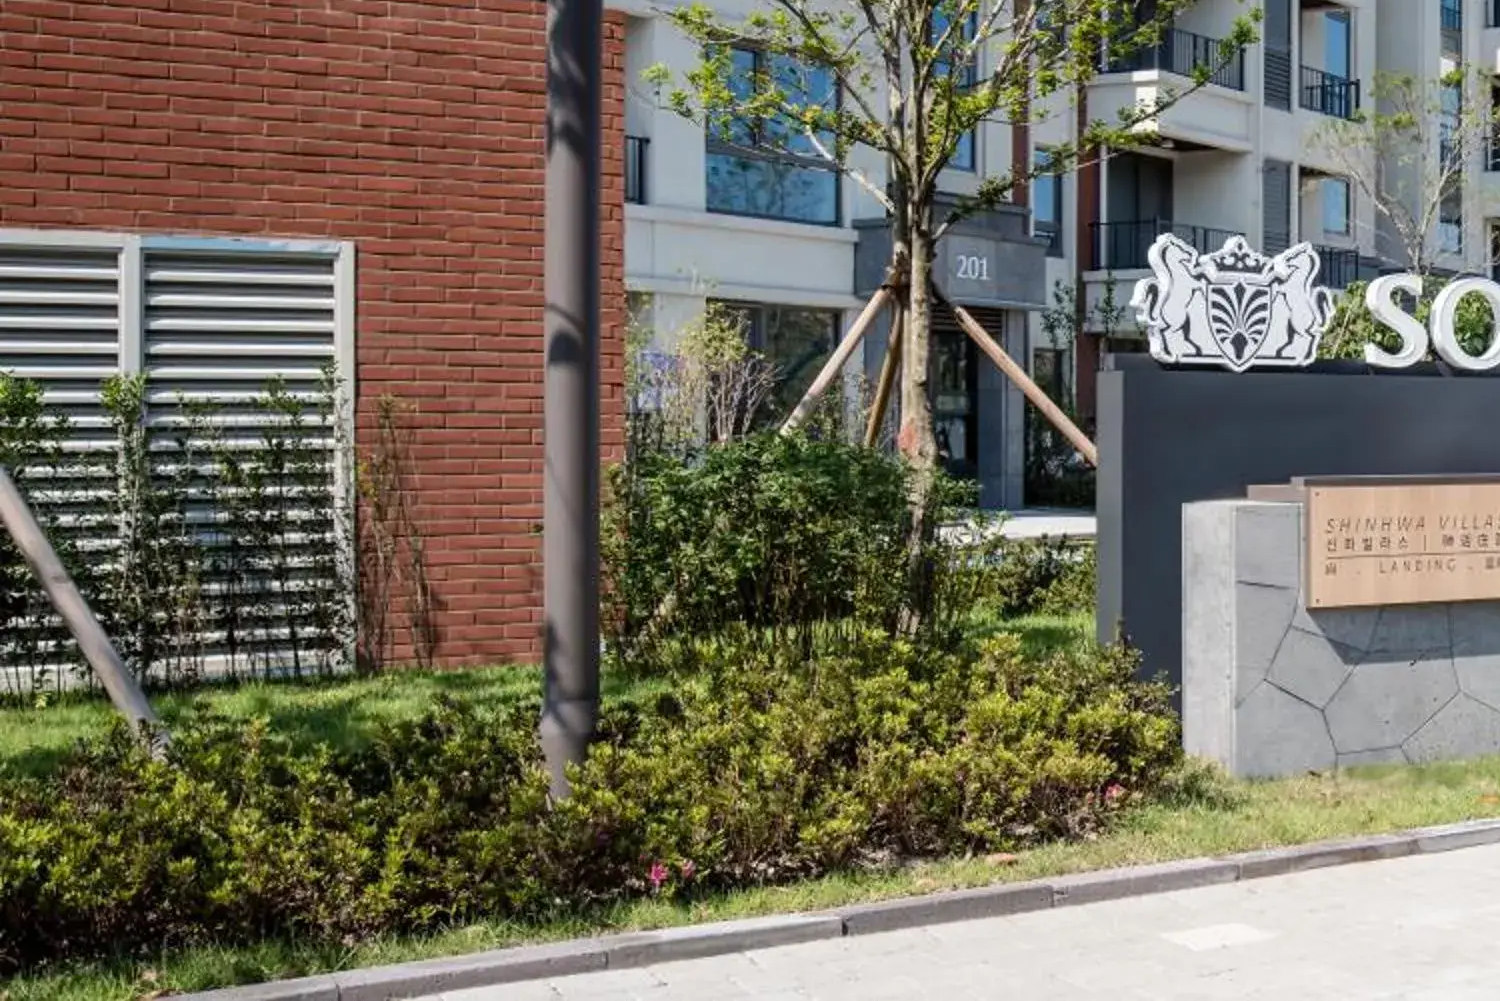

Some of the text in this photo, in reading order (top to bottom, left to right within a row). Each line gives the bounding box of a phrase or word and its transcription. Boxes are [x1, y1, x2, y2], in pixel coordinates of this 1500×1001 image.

[956, 255, 990, 280] 201
[1325, 515, 1425, 534] SHINHWA
[1379, 558, 1456, 574] LANDING
